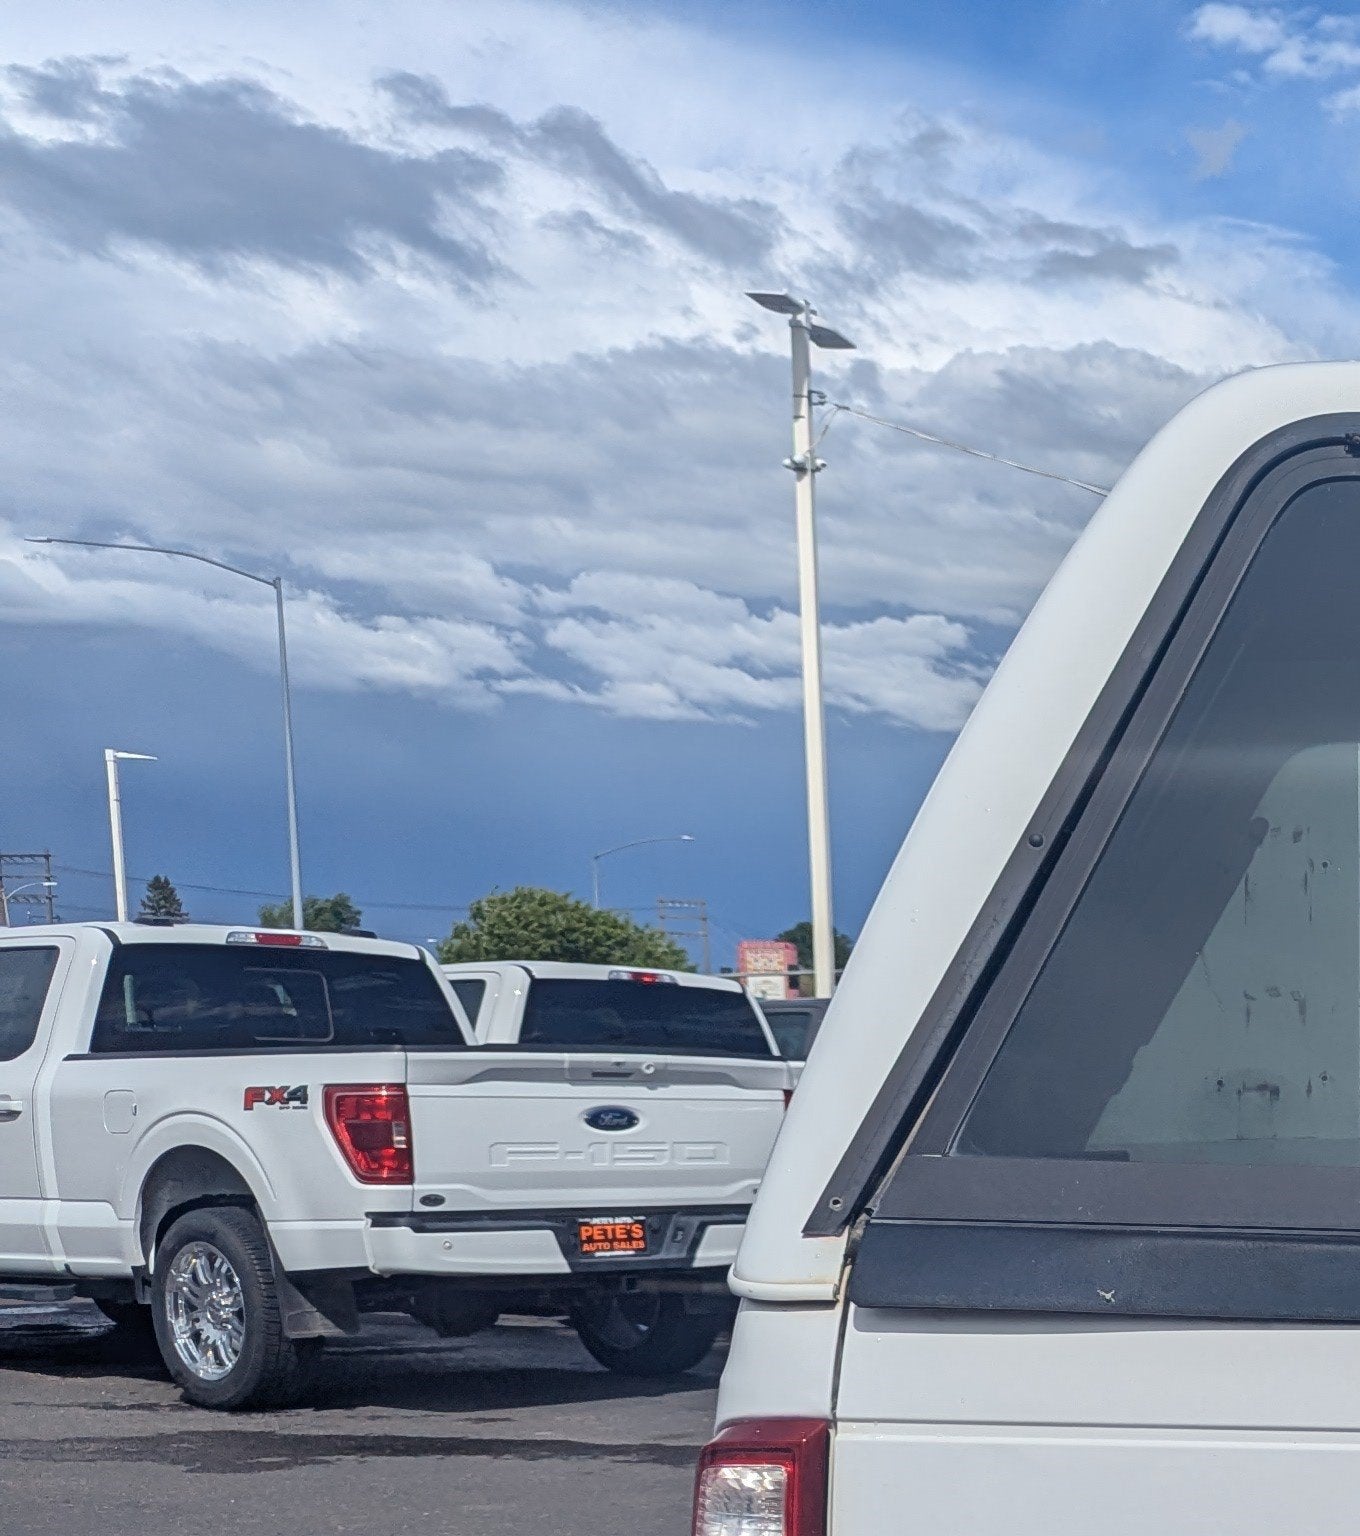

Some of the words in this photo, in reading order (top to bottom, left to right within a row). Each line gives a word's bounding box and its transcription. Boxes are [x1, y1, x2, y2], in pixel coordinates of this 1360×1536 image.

[243, 1084, 308, 1111] FX4
[488, 1141, 730, 1167] F-150
[580, 1223, 644, 1241] PETE'S
[582, 1241, 611, 1252] AUTO
